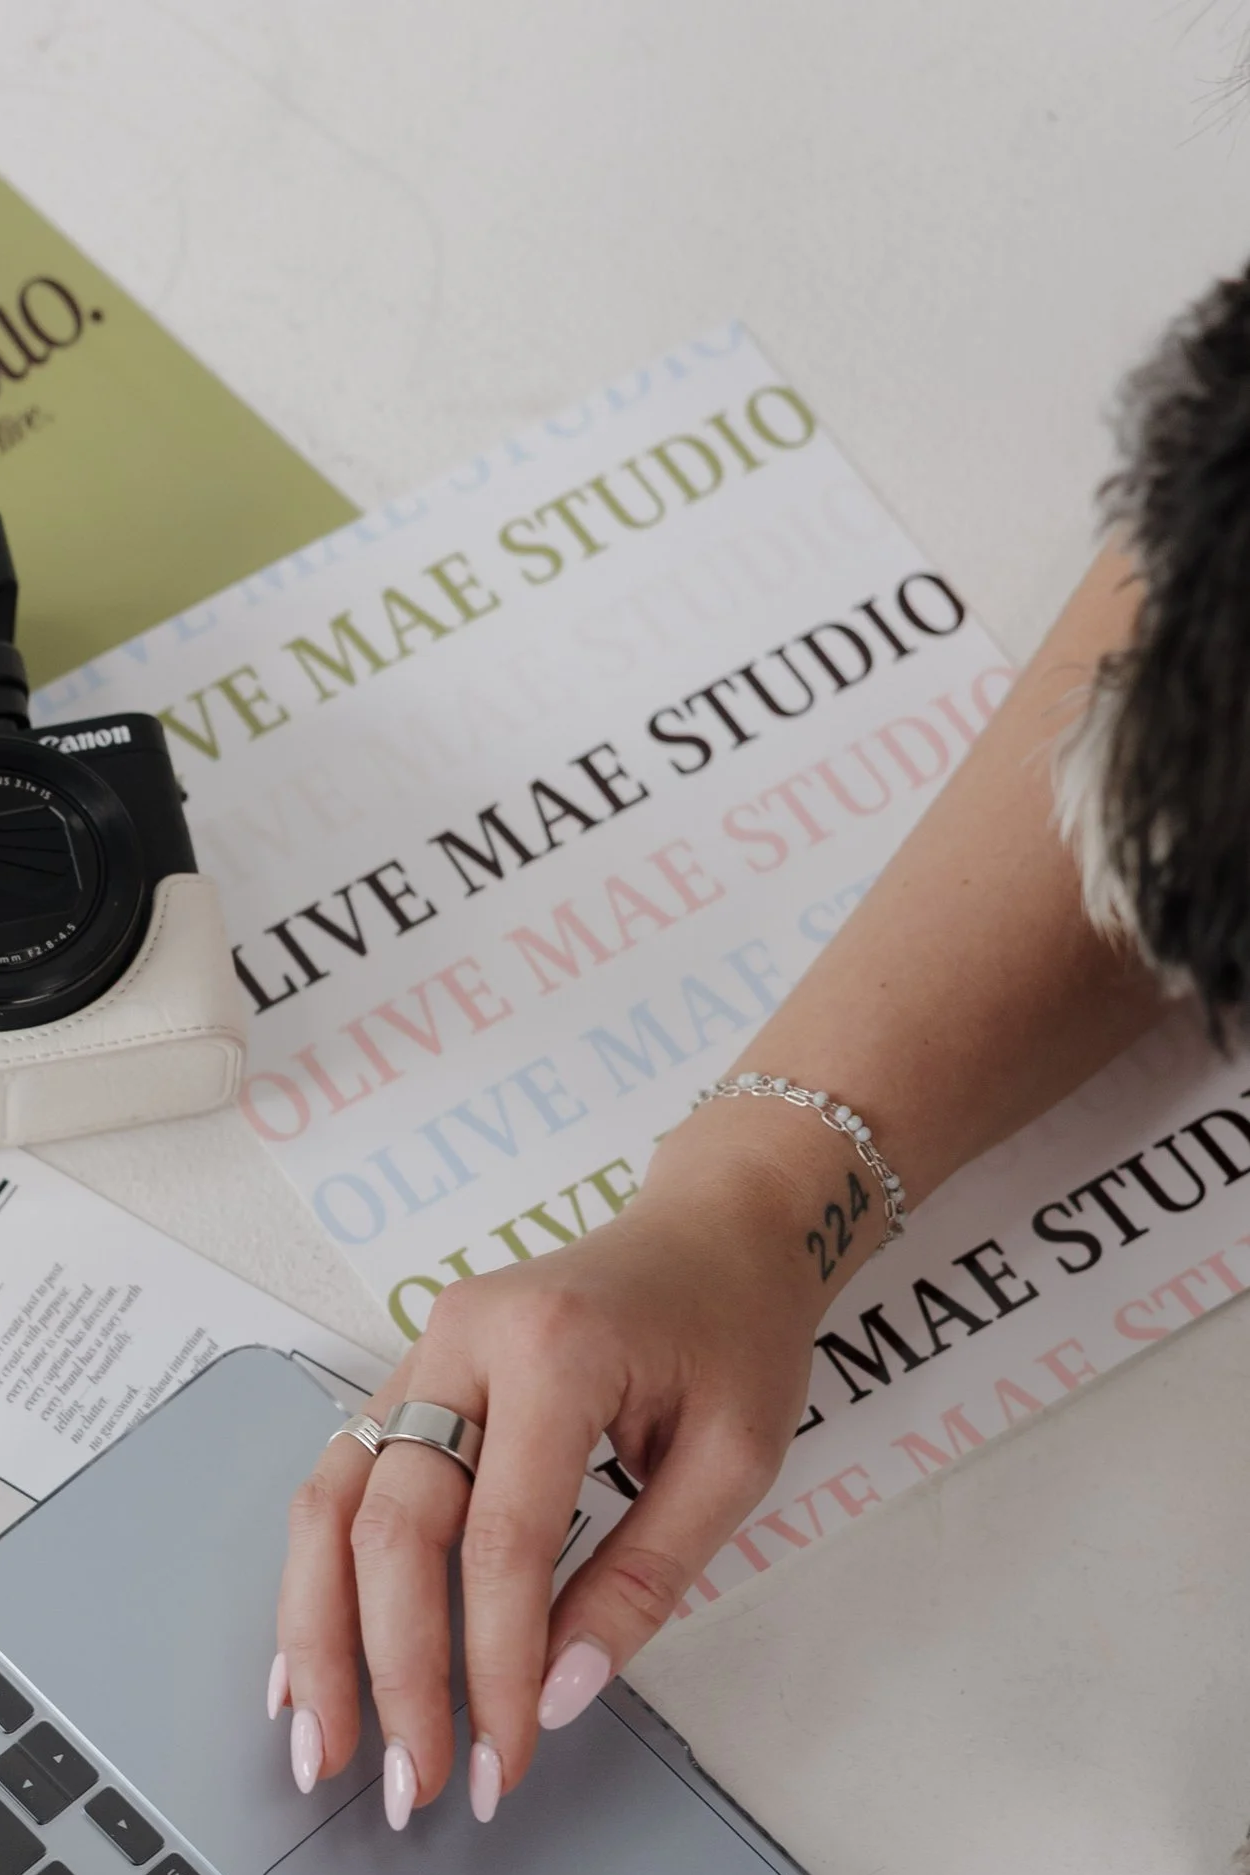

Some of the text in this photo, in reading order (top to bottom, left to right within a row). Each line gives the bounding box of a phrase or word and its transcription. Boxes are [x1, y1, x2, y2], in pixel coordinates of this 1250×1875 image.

[282, 552, 501, 705] MAE
[498, 385, 819, 585] STUDIO
[429, 743, 650, 897] MAE
[647, 573, 967, 775] STUDIO
[238, 956, 515, 1148] OLIVE
[502, 838, 728, 998] MAE
[312, 1056, 590, 1246] OLIVE
[805, 1171, 871, 1285] 224
[818, 1239, 1039, 1404] MAE
[1030, 1088, 1250, 1276] STUD
